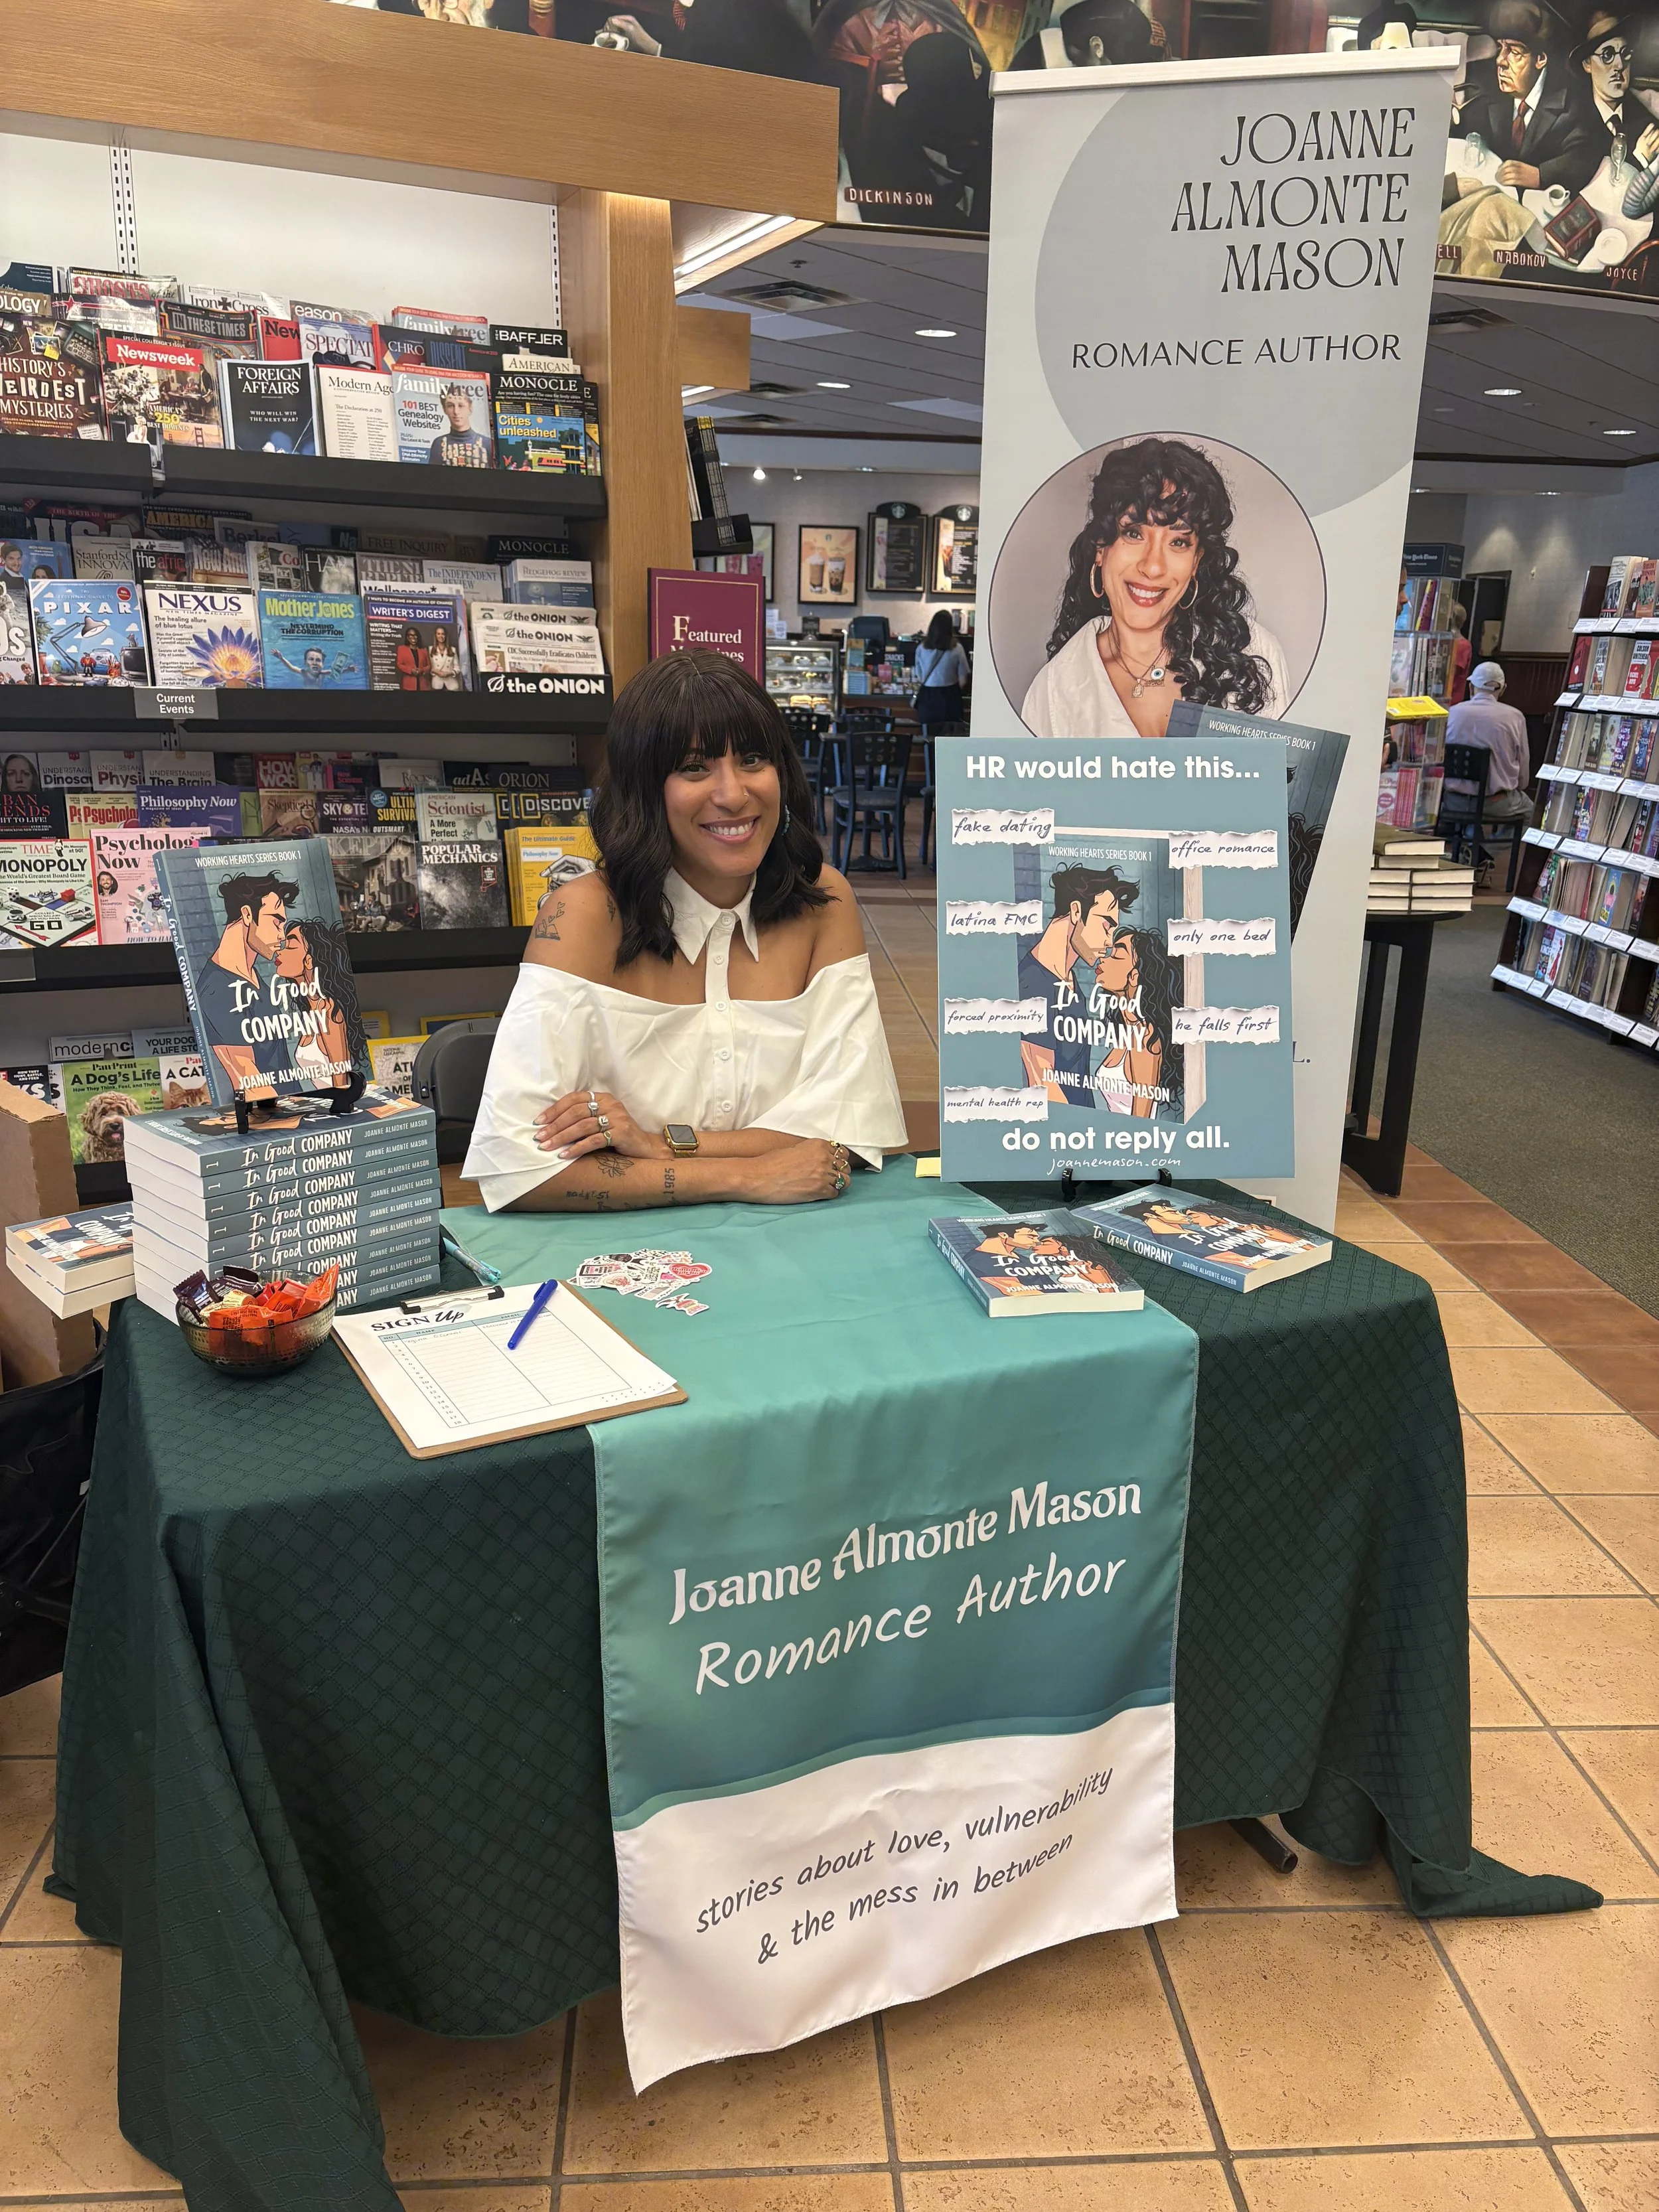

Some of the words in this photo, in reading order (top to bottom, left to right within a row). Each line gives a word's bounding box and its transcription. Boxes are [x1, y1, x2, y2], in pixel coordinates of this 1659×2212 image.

[1220, 108, 1415, 166] JOANNE
[850, 188, 932, 205] DICKINSON
[1171, 173, 1409, 231] ALMONTE
[1221, 238, 1404, 293] MASON
[1497, 251, 1546, 267] NABOKOV
[1607, 267, 1638, 281] JOYCE
[190, 295, 218, 309] Iron
[232, 299, 269, 316] Cross
[117, 344, 196, 366] Newsweek
[1072, 339, 1243, 368] ROMANCE
[1254, 334, 1401, 365] AUTHOR
[0, 357, 66, 378] HISTORY'S
[509, 358, 570, 372] AMERICAN
[238, 366, 301, 383] FOREIGN
[328, 376, 373, 390] Modern
[243, 380, 299, 396] AFFAIRS
[500, 377, 577, 392] MONOCLE
[1, 399, 74, 420] MYSTERIES
[403, 400, 417, 409] 101
[419, 401, 439, 412] BEST
[155, 412, 180, 425] 250
[398, 409, 444, 423] Genealogy
[403, 418, 441, 431] Websites
[500, 415, 532, 427] Cities
[500, 427, 557, 439] unleashed
[76, 550, 119, 561] Stanford
[499, 540, 569, 554] MONOCLE
[137, 552, 156, 569] the
[428, 567, 441, 577] The
[442, 568, 498, 582] INDEPENDENT
[44, 601, 133, 615] PIXAR
[159, 593, 242, 612] NEXUS
[267, 597, 317, 618] Mother
[318, 601, 355, 619] Jones
[167, 616, 189, 625] healing
[372, 607, 415, 618] WRITER'S
[417, 609, 450, 619] DIGEST
[517, 629, 534, 639] the
[535, 631, 573, 642] ONION
[672, 615, 743, 644] Featured
[506, 677, 537, 693] the
[539, 678, 605, 694] ONION
[157, 694, 195, 703] Current
[160, 705, 194, 713] Events
[966, 757, 1006, 779] HR
[1014, 756, 1100, 780] would
[1112, 756, 1177, 780] hate
[1185, 756, 1260, 780] this...
[499, 773, 550, 788] ORION
[140, 795, 210, 811] Philosophy
[210, 796, 236, 808] Now
[427, 800, 486, 816] Scientist
[431, 829, 458, 838] Perfect
[954, 817, 992, 836] fake
[999, 816, 1052, 841] dating
[20, 844, 53, 854] TIME
[421, 844, 482, 855] POPULAR
[1171, 840, 1212, 860] office
[1217, 845, 1275, 855] romance
[97, 853, 141, 869] Now
[195, 856, 229, 868] WORKING
[230, 855, 255, 866] HEARTS
[256, 853, 278, 864] SERIES
[279, 851, 297, 862] BOOK
[298, 851, 303, 861] 1
[423, 853, 498, 865] MECHANICS
[30, 921, 62, 930] GO
[950, 911, 997, 927] latina
[1005, 913, 1039, 926] FMC
[1173, 930, 1202, 944] only
[1210, 932, 1236, 942] one
[1243, 929, 1270, 942] bed
[228, 978, 259, 1013] In
[270, 967, 326, 1007] Good
[1050, 980, 1080, 1010] In
[1088, 982, 1146, 1019] Good
[241, 1008, 330, 1043] COMPANY
[947, 1009, 985, 1025] forced
[987, 1011, 1045, 1029] proximity
[1053, 1014, 1146, 1054] COMPANY
[1175, 1018, 1192, 1031] he
[1198, 1018, 1231, 1039] falls
[1236, 1017, 1279, 1041] first
[146, 1038, 173, 1047] YOUR
[173, 1036, 195, 1045] DOG
[71, 1074, 84, 1086] A
[86, 1071, 130, 1085] Dog's
[133, 1069, 161, 1081] Life
[166, 1069, 177, 1080] A
[238, 1070, 276, 1091] JOANNE
[278, 1065, 319, 1084] ALMONTE
[320, 1059, 352, 1078] MASON
[1042, 1067, 1080, 1088] JOANNE
[1082, 1074, 1131, 1096] ALMONTE
[1133, 1084, 1170, 1104] MASON
[946, 1098, 986, 1108] mental
[988, 1097, 1022, 1107] health
[1026, 1100, 1044, 1112] rep
[241, 1147, 259, 1168] In
[264, 1137, 297, 1164] Good
[301, 1129, 353, 1152] COMPANY
[364, 1127, 384, 1138] JOANNE
[385, 1123, 409, 1135] ALMONTE
[409, 1119, 428, 1130] MASON
[1001, 1127, 1040, 1152] do
[1050, 1128, 1096, 1151] not
[1104, 1126, 1177, 1156] reply
[1185, 1124, 1230, 1148] all.
[1046, 1155, 1182, 1177] joannemason.com
[664, 1167, 674, 1195] 1985
[1092, 1225, 1104, 1240] In
[1106, 1230, 1129, 1250] Good
[1133, 1238, 1175, 1265] COMPANY
[1181, 1260, 1198, 1271] JOANNE
[1198, 1264, 1220, 1280] ALMONTE
[1220, 1274, 1238, 1287] MASON
[371, 1315, 431, 1333] SIGN
[435, 1309, 465, 1326] Up
[669, 1555, 821, 1625] Joanne
[831, 1507, 997, 1582] Almonte
[1007, 1481, 1141, 1536] Mason
[695, 1601, 932, 1696] Romance
[956, 1552, 1127, 1626] Author
[695, 1872, 784, 1935] stories
[797, 1838, 876, 1886] about
[887, 1828, 951, 1857] love,
[965, 1767, 1115, 1842] vulnerability
[757, 1932, 780, 1966] &
[790, 1909, 836, 1947] the
[849, 1882, 919, 1923] mess
[934, 1876, 960, 1904] in
[974, 1832, 1074, 1895] between
